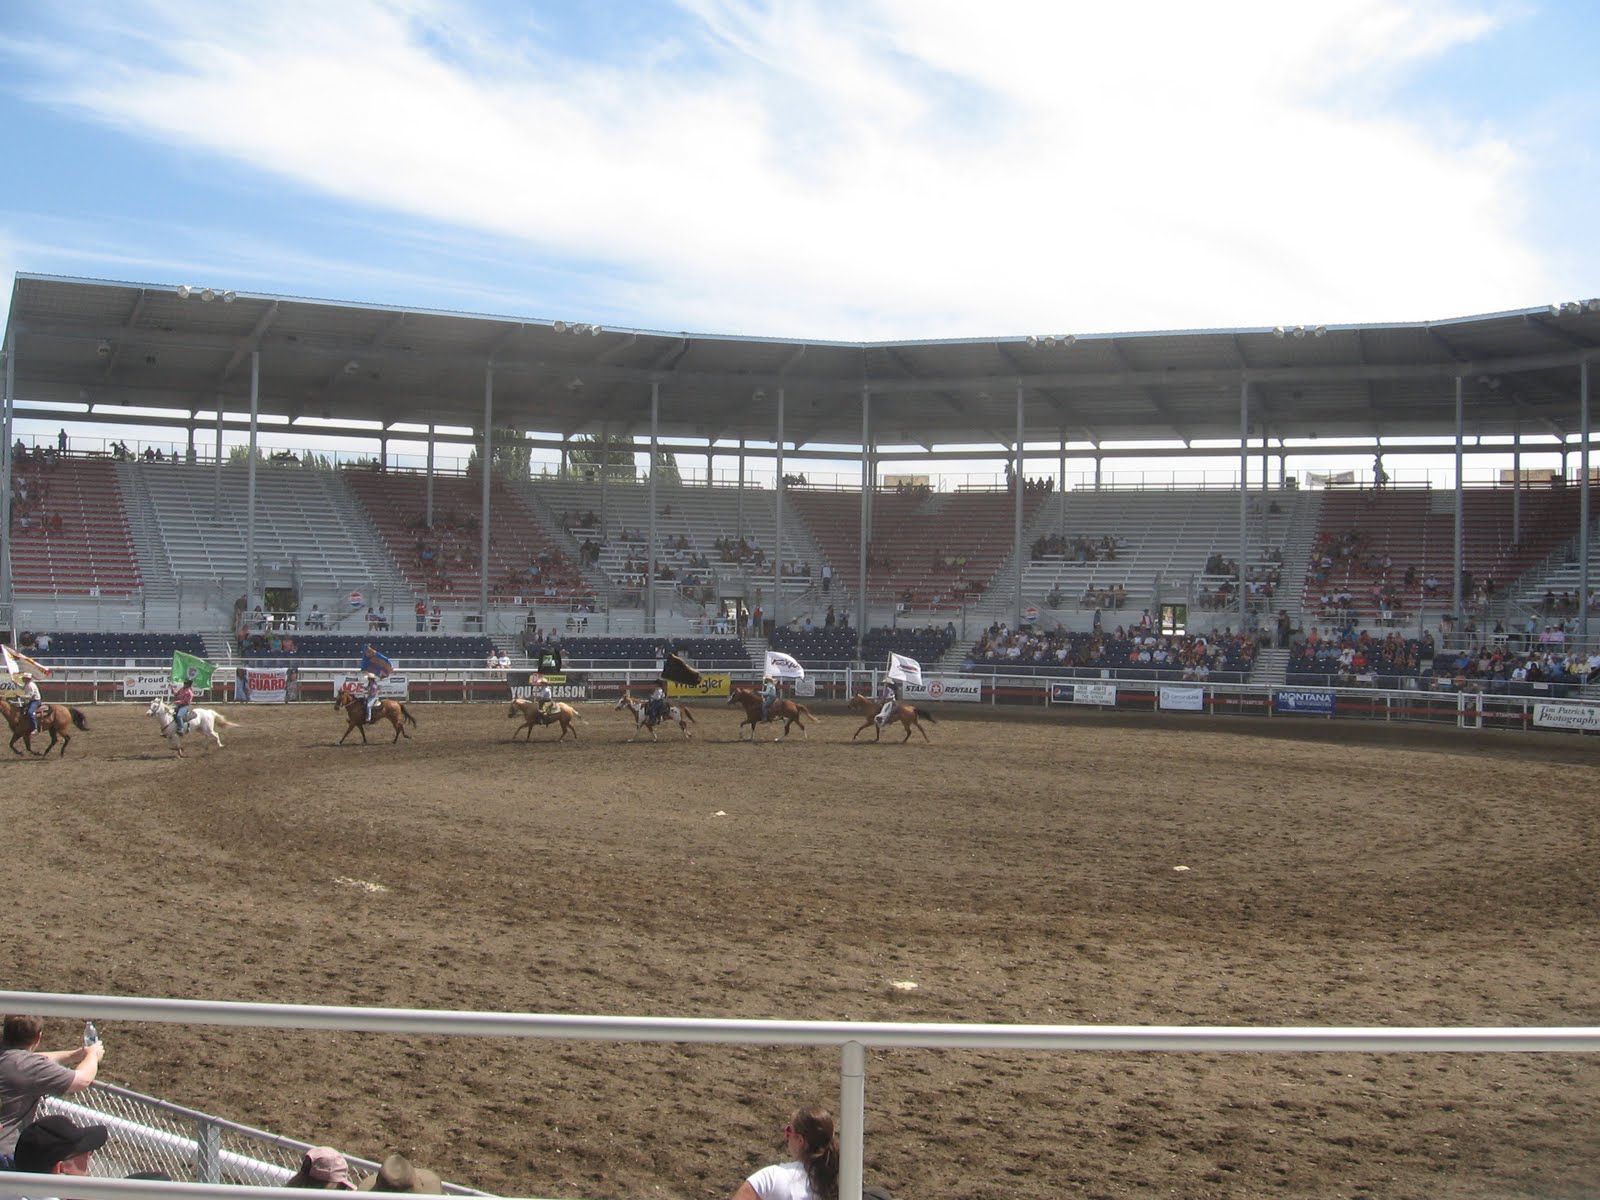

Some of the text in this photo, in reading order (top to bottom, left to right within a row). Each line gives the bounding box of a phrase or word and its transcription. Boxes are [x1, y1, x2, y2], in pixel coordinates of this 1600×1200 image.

[249, 679, 285, 690] GUARD
[905, 685, 979, 694] STAR RENTALS
[1279, 692, 1332, 702] MONTANA
[1540, 705, 1586, 716] Tim Patrick
[1539, 712, 1600, 727] Photography
